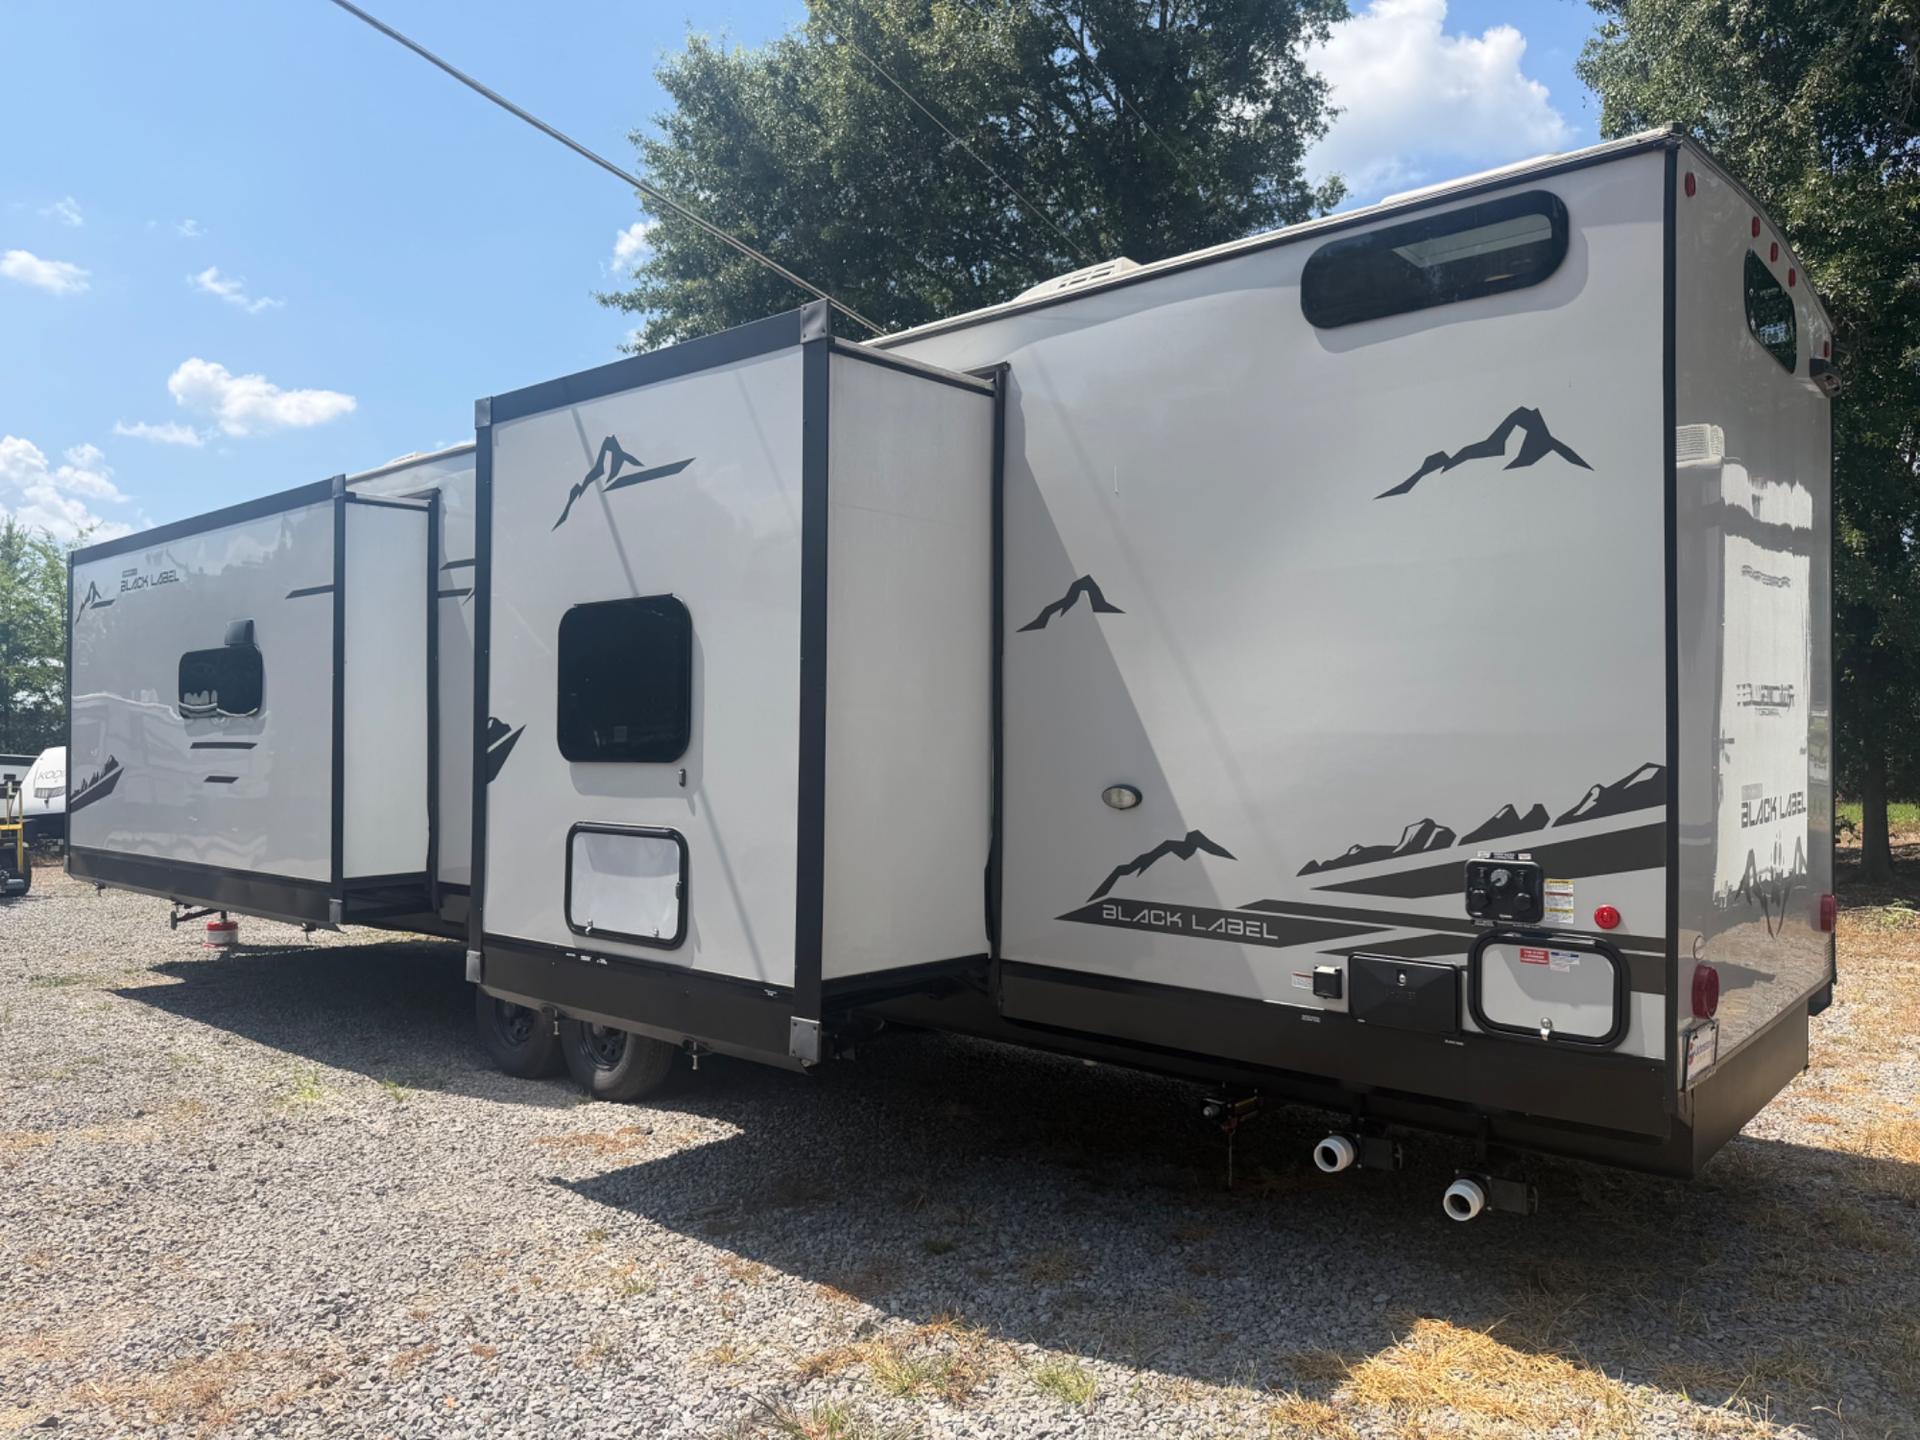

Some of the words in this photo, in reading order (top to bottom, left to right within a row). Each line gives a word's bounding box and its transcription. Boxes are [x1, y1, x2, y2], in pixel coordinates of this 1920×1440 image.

[120, 575, 149, 593] BLACK
[151, 569, 180, 586] LABEL
[1741, 796, 1777, 829] BLACK
[1779, 791, 1807, 819] LABEL
[1102, 904, 1183, 928] BLACK
[1191, 914, 1279, 940] LABEL
